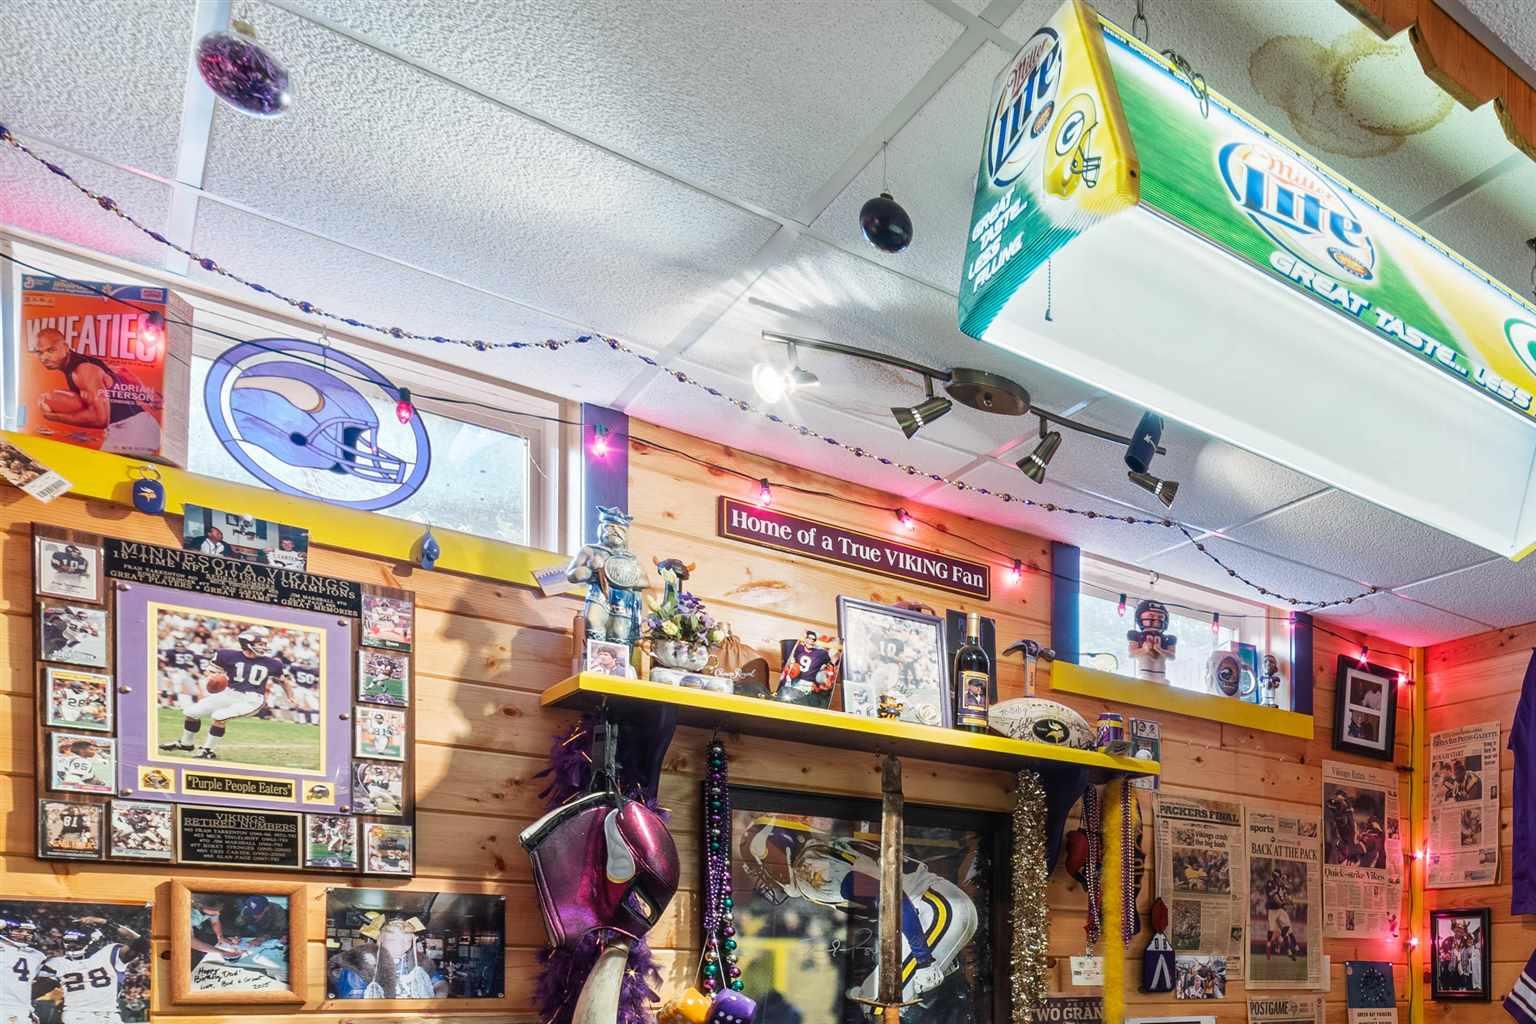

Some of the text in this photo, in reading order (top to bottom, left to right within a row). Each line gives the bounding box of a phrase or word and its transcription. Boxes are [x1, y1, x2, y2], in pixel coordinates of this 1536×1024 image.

[1007, 38, 1048, 95] Miller
[994, 40, 1061, 178] Lite
[1252, 146, 1334, 202] Miller
[972, 184, 1016, 241] GREAT
[1243, 161, 1365, 248] Lite
[968, 233, 1001, 280] LESS
[1269, 251, 1372, 319] GREAT
[1473, 366, 1533, 411] LESS
[97, 388, 154, 401] PETERSON
[114, 382, 155, 394] ADRIAN
[732, 509, 984, 589] Home of a True VIKING Fan
[119, 541, 258, 576] MINNESOTA
[266, 565, 352, 593] VIKINGS
[181, 562, 209, 576] NFL
[214, 567, 276, 585] DIVISION
[281, 579, 356, 600] CHAMPIONS
[110, 570, 143, 583] GREAT
[148, 575, 192, 590] PLAYERS
[203, 586, 235, 597] GREAT
[240, 591, 271, 603] TEAMS
[281, 598, 310, 609] GREAT
[313, 601, 359, 617] MEMORIES
[233, 662, 269, 686] 10
[799, 655, 812, 672] 9
[296, 671, 314, 684] 50
[225, 779, 257, 794] People
[64, 816, 78, 828] 81
[184, 817, 297, 832] RETIRED NUMBERS
[216, 813, 265, 823] VIKINGS
[1160, 805, 1239, 823] PACKERS FINAL
[1250, 824, 1274, 834] sports
[1252, 843, 1317, 861] BACK AT THE PACK
[12, 958, 30, 983] 4
[60, 965, 112, 993] 28
[1250, 1001, 1288, 1016] POSTGAME
